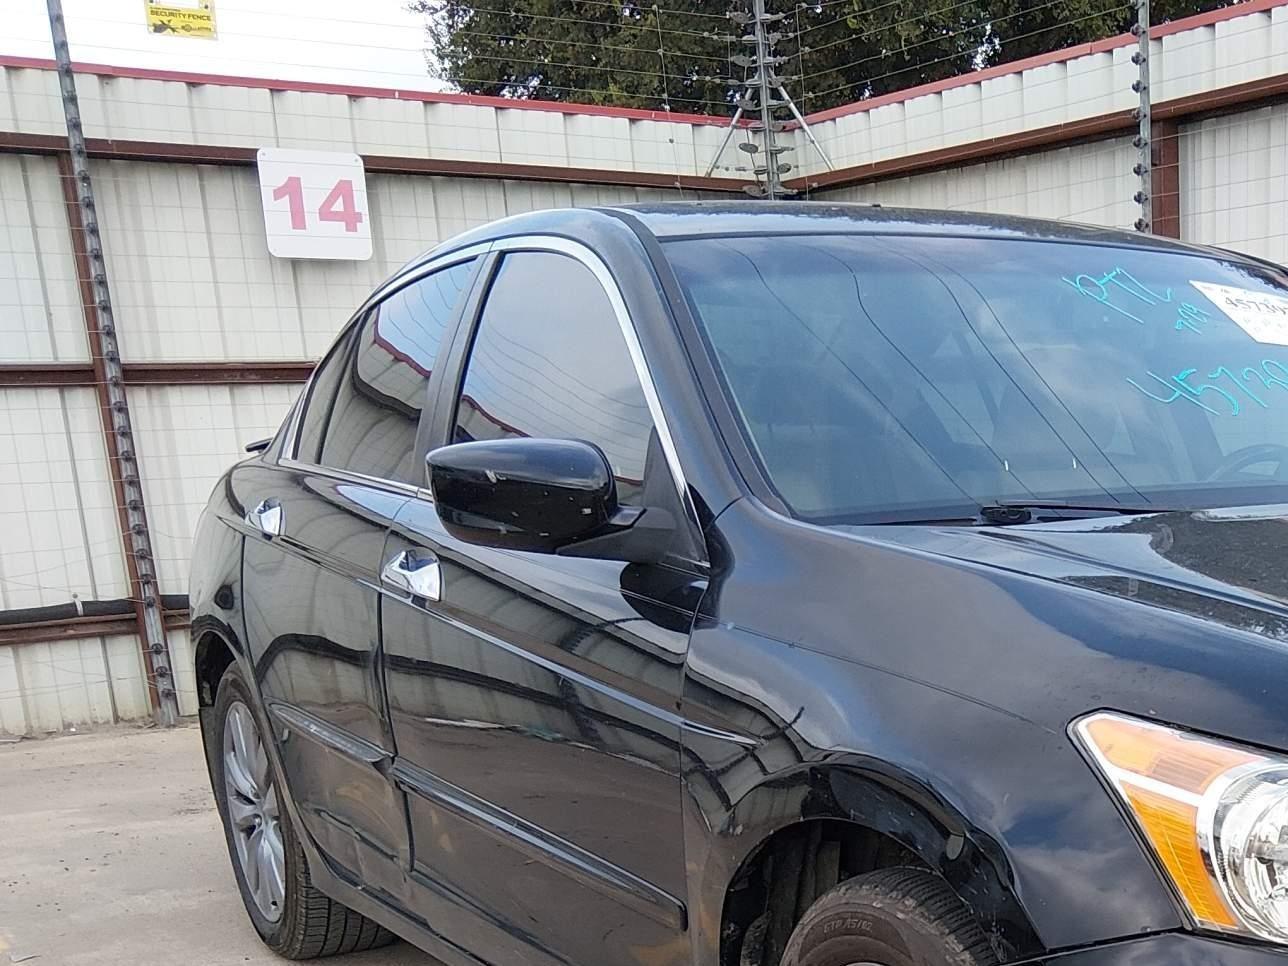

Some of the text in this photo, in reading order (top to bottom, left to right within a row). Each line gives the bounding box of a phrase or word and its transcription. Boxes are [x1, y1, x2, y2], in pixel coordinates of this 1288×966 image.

[150, 10, 186, 18] SECURITY
[187, 13, 211, 21] FENCE
[273, 176, 363, 232] 14
